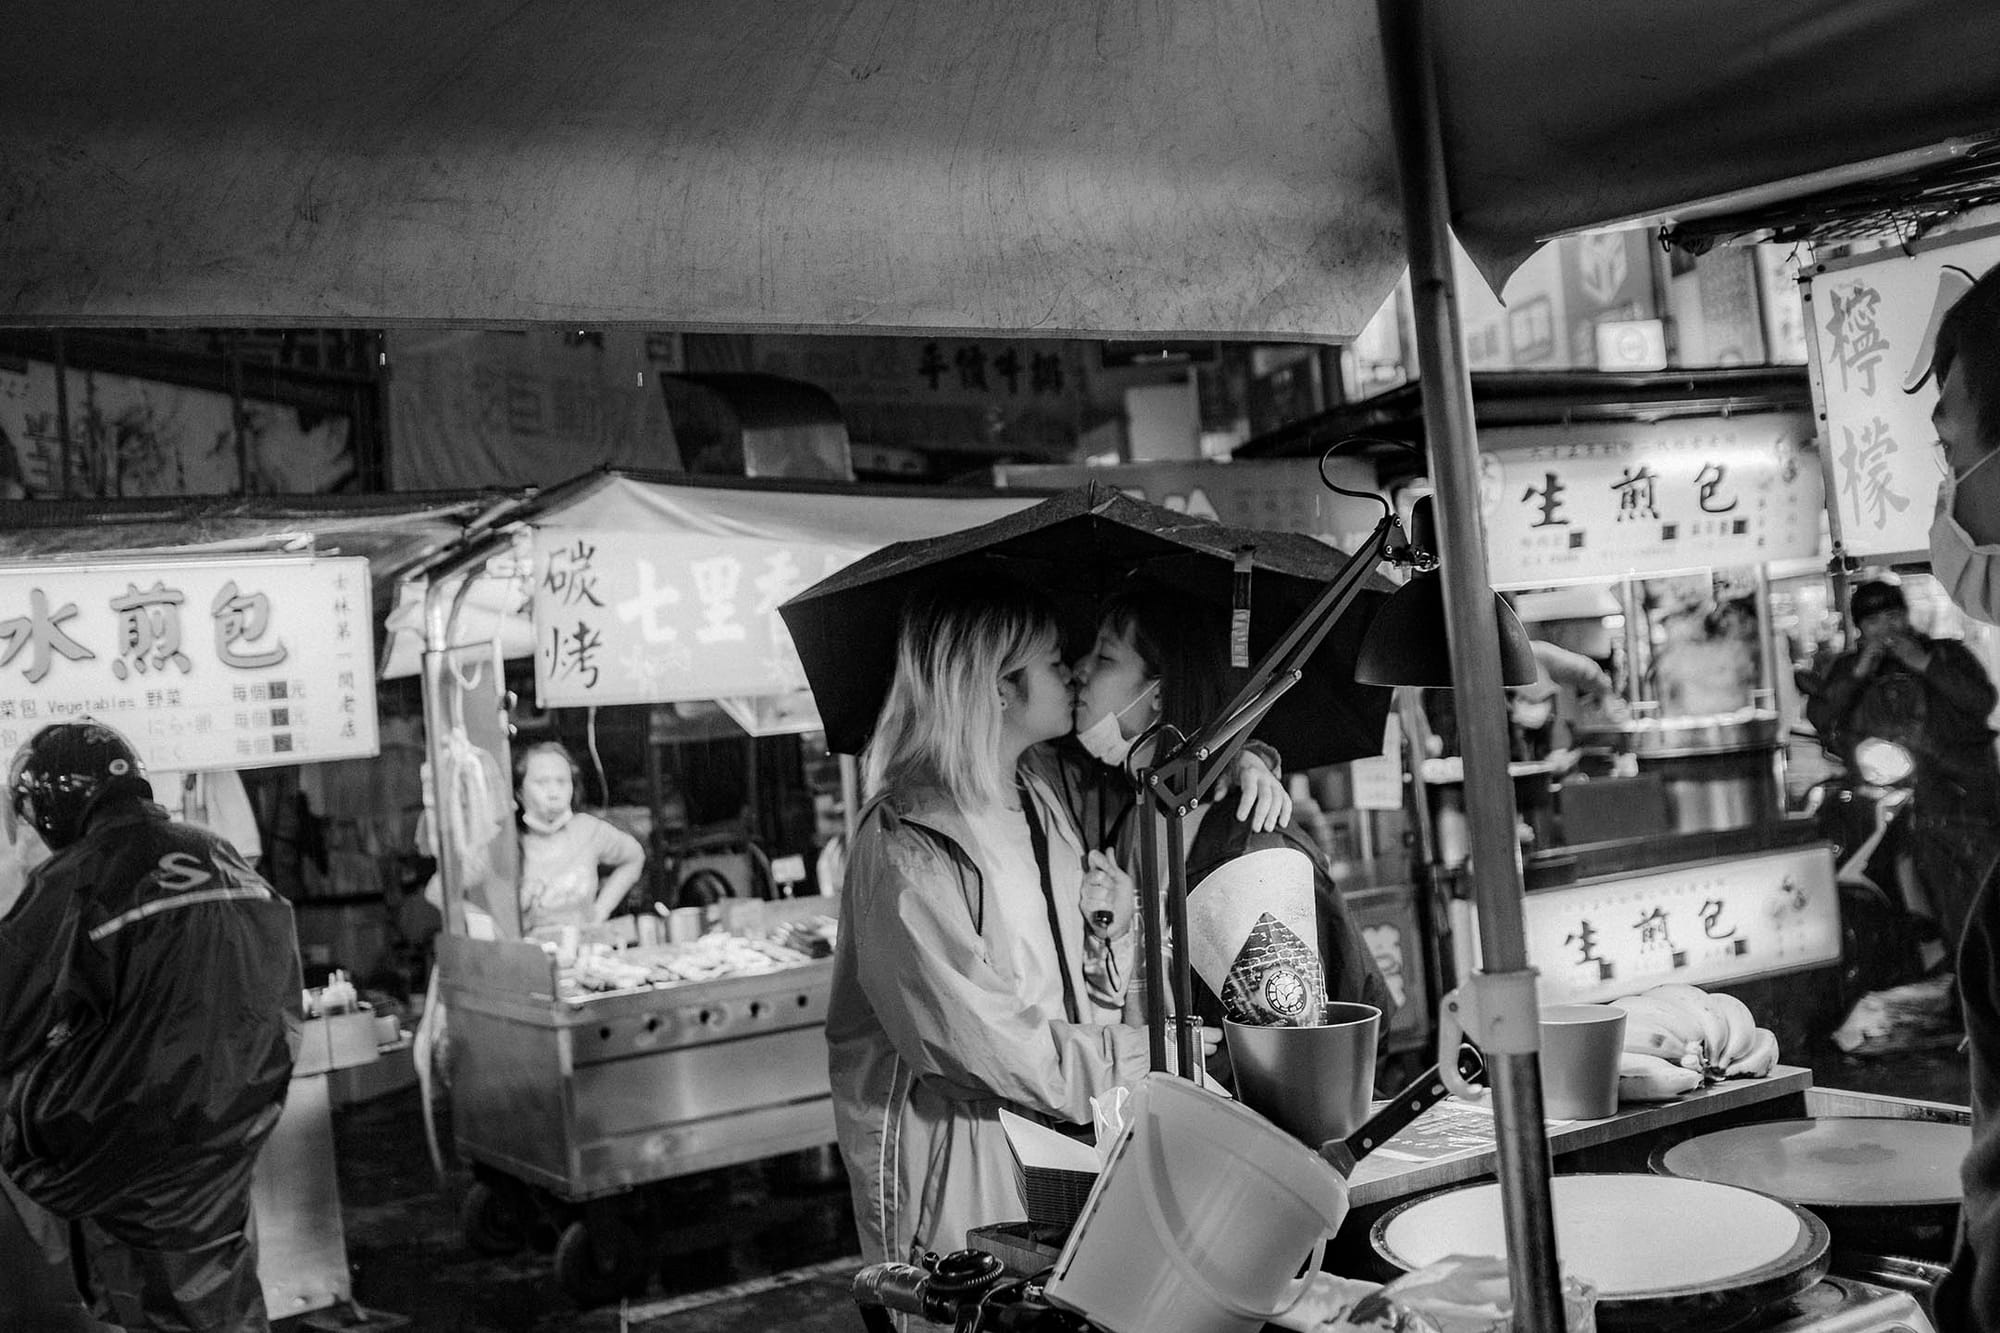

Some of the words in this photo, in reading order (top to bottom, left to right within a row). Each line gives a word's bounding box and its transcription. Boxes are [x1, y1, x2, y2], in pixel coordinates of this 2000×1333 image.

[1826, 285, 1910, 531] 檸檬
[1521, 462, 1738, 528] 生煎包
[0, 580, 288, 684] 水煎包
[543, 540, 605, 689] 碳烤
[1563, 898, 1737, 966] 生煎包
